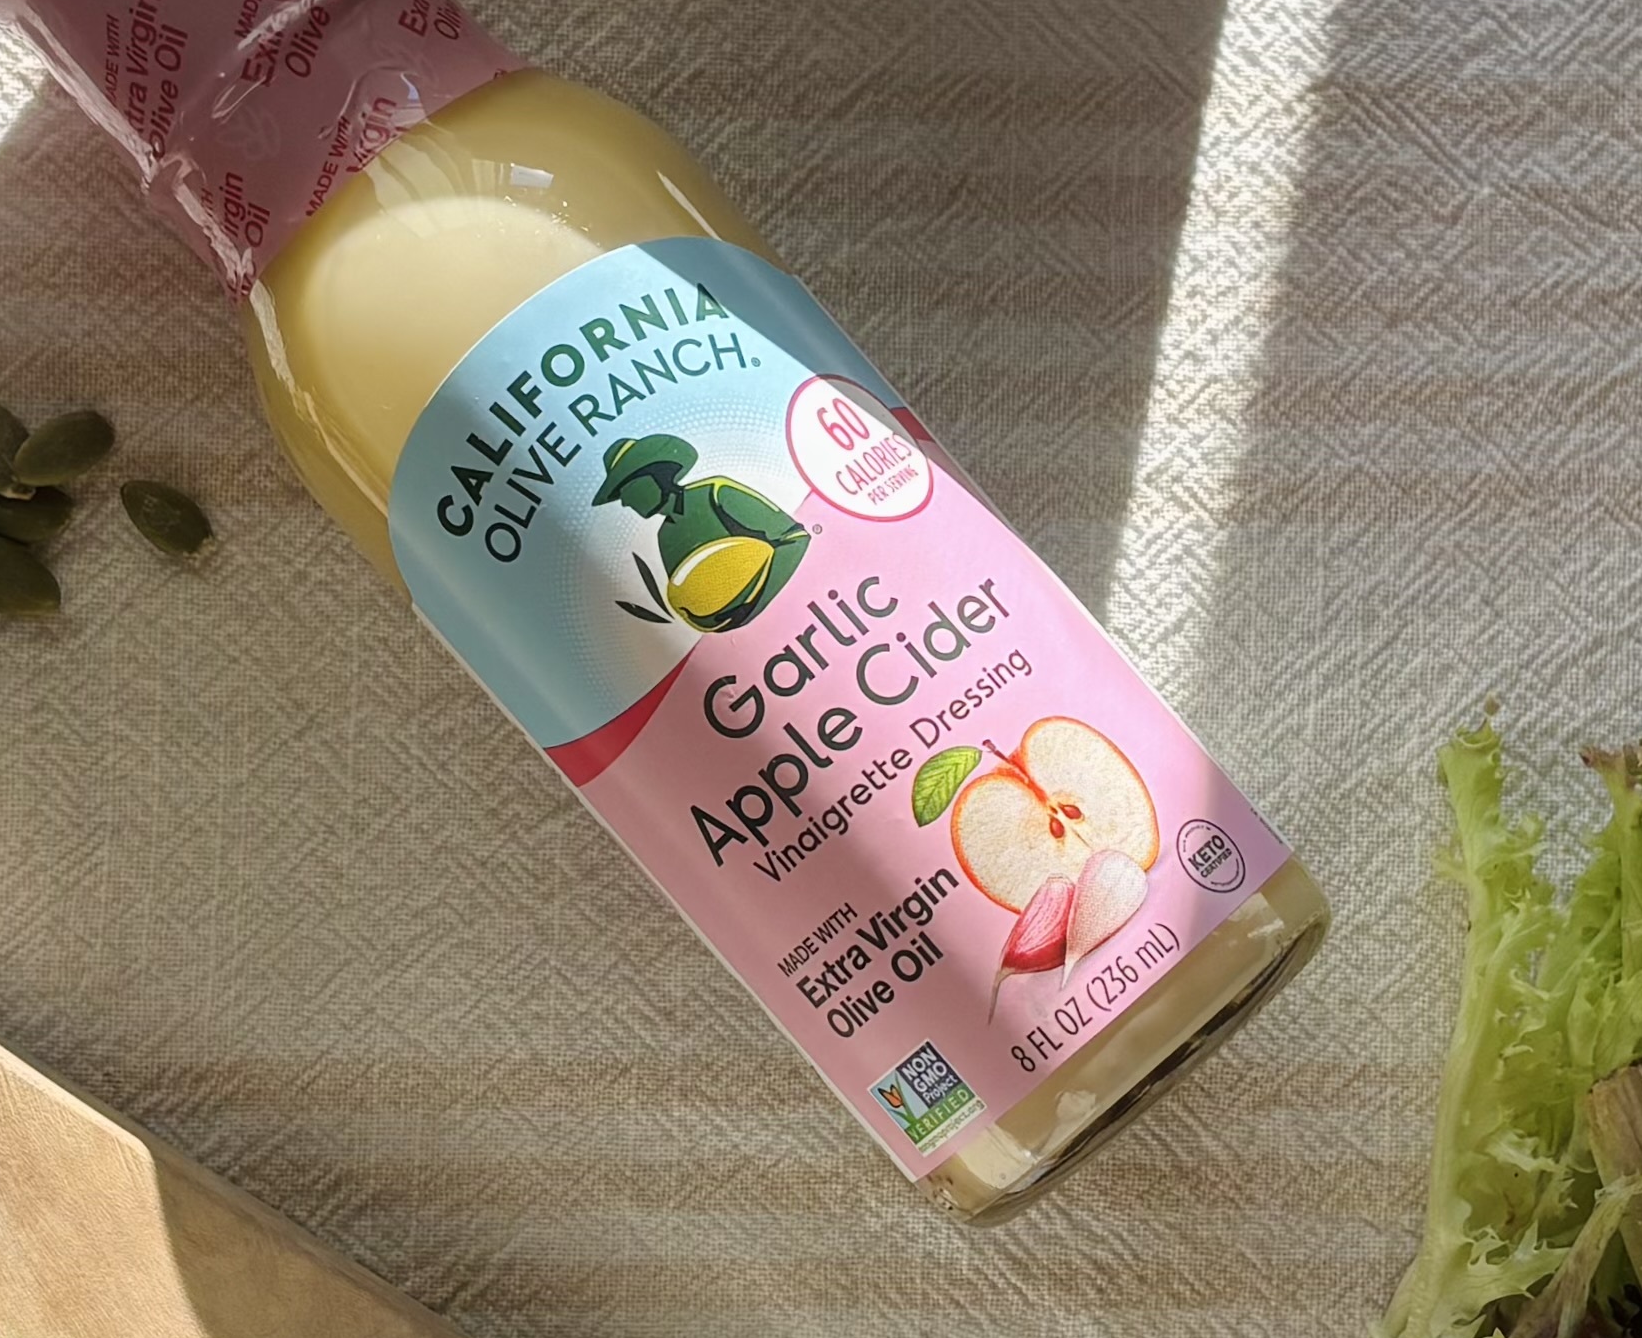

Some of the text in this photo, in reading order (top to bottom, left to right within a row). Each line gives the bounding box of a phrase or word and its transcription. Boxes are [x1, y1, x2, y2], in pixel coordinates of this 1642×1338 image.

[106, 14, 120, 59] WITH
[154, 24, 189, 72] Oil
[285, 6, 330, 78] Olive
[329, 116, 349, 160] WITH
[219, 171, 244, 238] irgin
[245, 203, 270, 247] Oil
[437, 283, 730, 537] CALIFORNIA
[817, 398, 870, 450] 60
[835, 432, 911, 495] CALORIES
[867, 464, 919, 505] PER SERVING
[485, 422, 582, 563] OLIVE
[703, 576, 898, 739] Garlic
[689, 578, 1010, 866] Apple Cider
[753, 649, 1033, 882] Vinaigrette Dressing
[1188, 835, 1225, 871] KETO
[1200, 848, 1233, 878] CERTIFIED
[777, 902, 858, 977] MADE WITH
[796, 868, 959, 1009] Extra Virgin
[827, 931, 944, 1038] Olive Oil
[1011, 923, 1180, 1072] 8 FL OZ (236 mL)
[901, 1048, 937, 1081] NON
[914, 1061, 947, 1092] GMO
[922, 1074, 958, 1104] Project
[907, 1089, 969, 1140] VERIFIED
